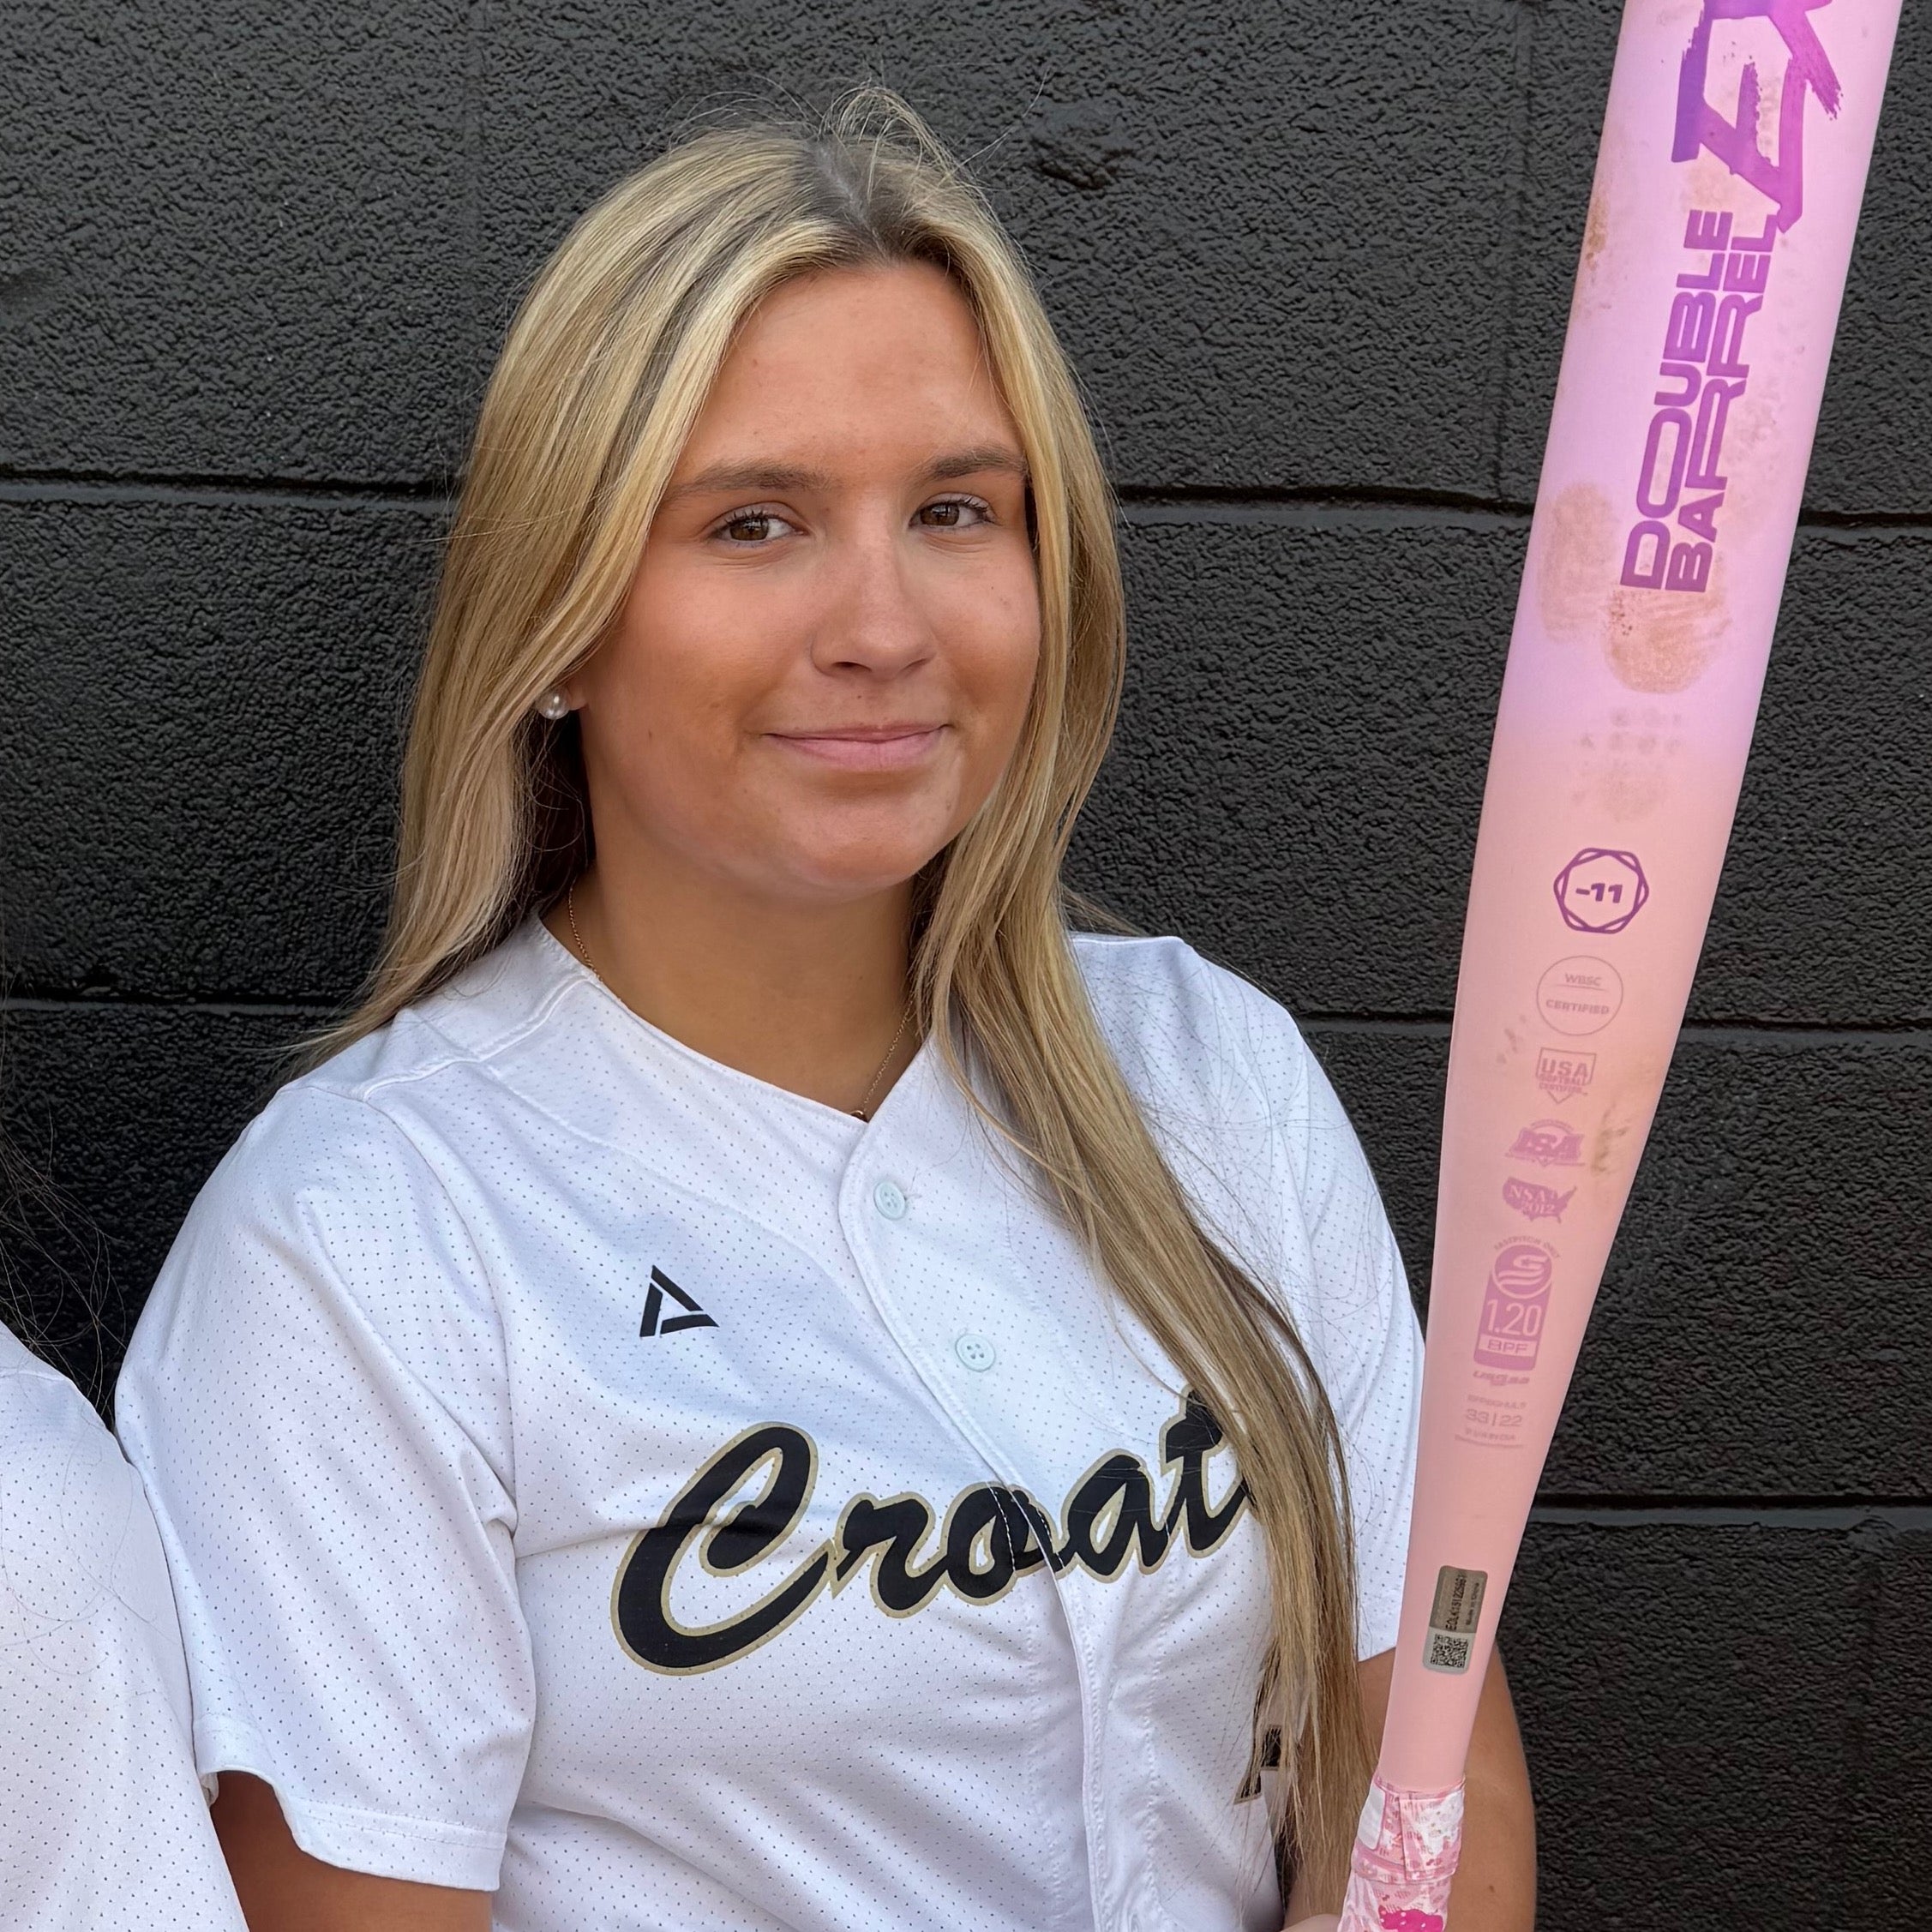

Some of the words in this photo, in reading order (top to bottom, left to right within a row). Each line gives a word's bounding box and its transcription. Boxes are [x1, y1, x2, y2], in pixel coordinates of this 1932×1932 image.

[1619, 209, 1734, 590] DOUBLE
[1665, 213, 1779, 593] BARREL
[1575, 883, 1623, 903] -11
[1564, 973, 1602, 987] WBSC
[1545, 999, 1610, 1016] CERTIFIED
[1541, 1057, 1588, 1077] USA
[1486, 1299, 1542, 1337] 1.20
[1487, 1339, 1529, 1354] BPF
